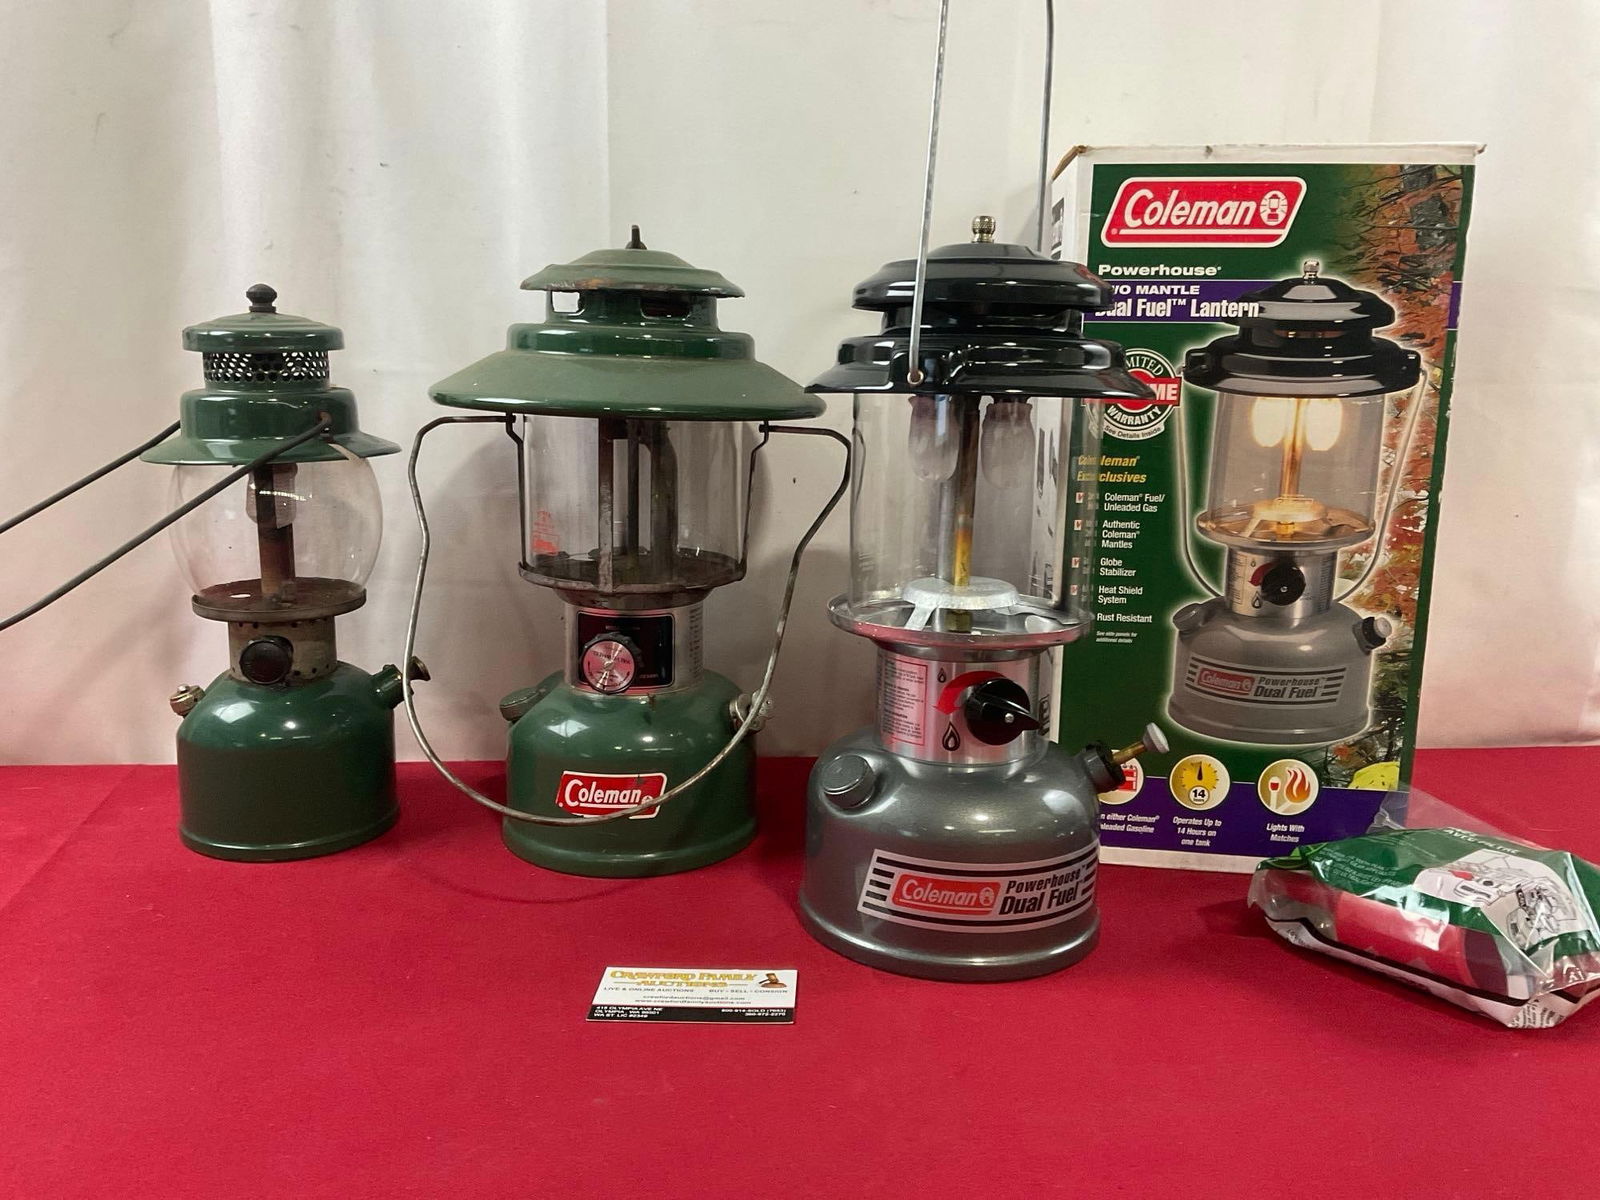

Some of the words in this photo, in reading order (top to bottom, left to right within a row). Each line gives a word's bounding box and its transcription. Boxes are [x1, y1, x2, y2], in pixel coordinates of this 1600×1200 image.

[1124, 189, 1257, 226] Coleman
[1136, 285, 1200, 295] MANTLE
[1190, 299, 1260, 318] Lantern
[1107, 405, 1162, 425] WARRANTY
[1117, 431, 1140, 439] Details
[1142, 427, 1161, 437] Inside
[1144, 494, 1166, 502] Fuel/
[1104, 503, 1141, 512] Unleaded
[1142, 503, 1158, 512] Gas
[1102, 520, 1140, 529] Authentic
[1102, 540, 1133, 549] Mantles
[1100, 558, 1123, 567] Globe
[1100, 568, 1137, 576] Stabilizer
[1099, 585, 1117, 594] Heat
[1118, 586, 1143, 595] Shield
[1098, 595, 1127, 605] System
[1097, 613, 1115, 622] Rust
[1116, 614, 1152, 623] Resistant
[1200, 671, 1240, 690] Coleman
[1254, 686, 1286, 698] Dual
[1288, 686, 1318, 698] Fuel
[565, 779, 642, 807] Coleman
[1192, 789, 1206, 798] 14
[1173, 816, 1204, 826] Operates
[1204, 818, 1214, 827] Up
[1177, 827, 1186, 835] 14
[1187, 828, 1206, 836] Hours
[1266, 823, 1288, 833] Lights
[1289, 824, 1305, 832] With
[1195, 838, 1211, 846] tank
[1270, 834, 1299, 843] Matches
[902, 879, 977, 906] Coleman
[999, 892, 1043, 916] Dual
[1048, 882, 1079, 909] Fuel
